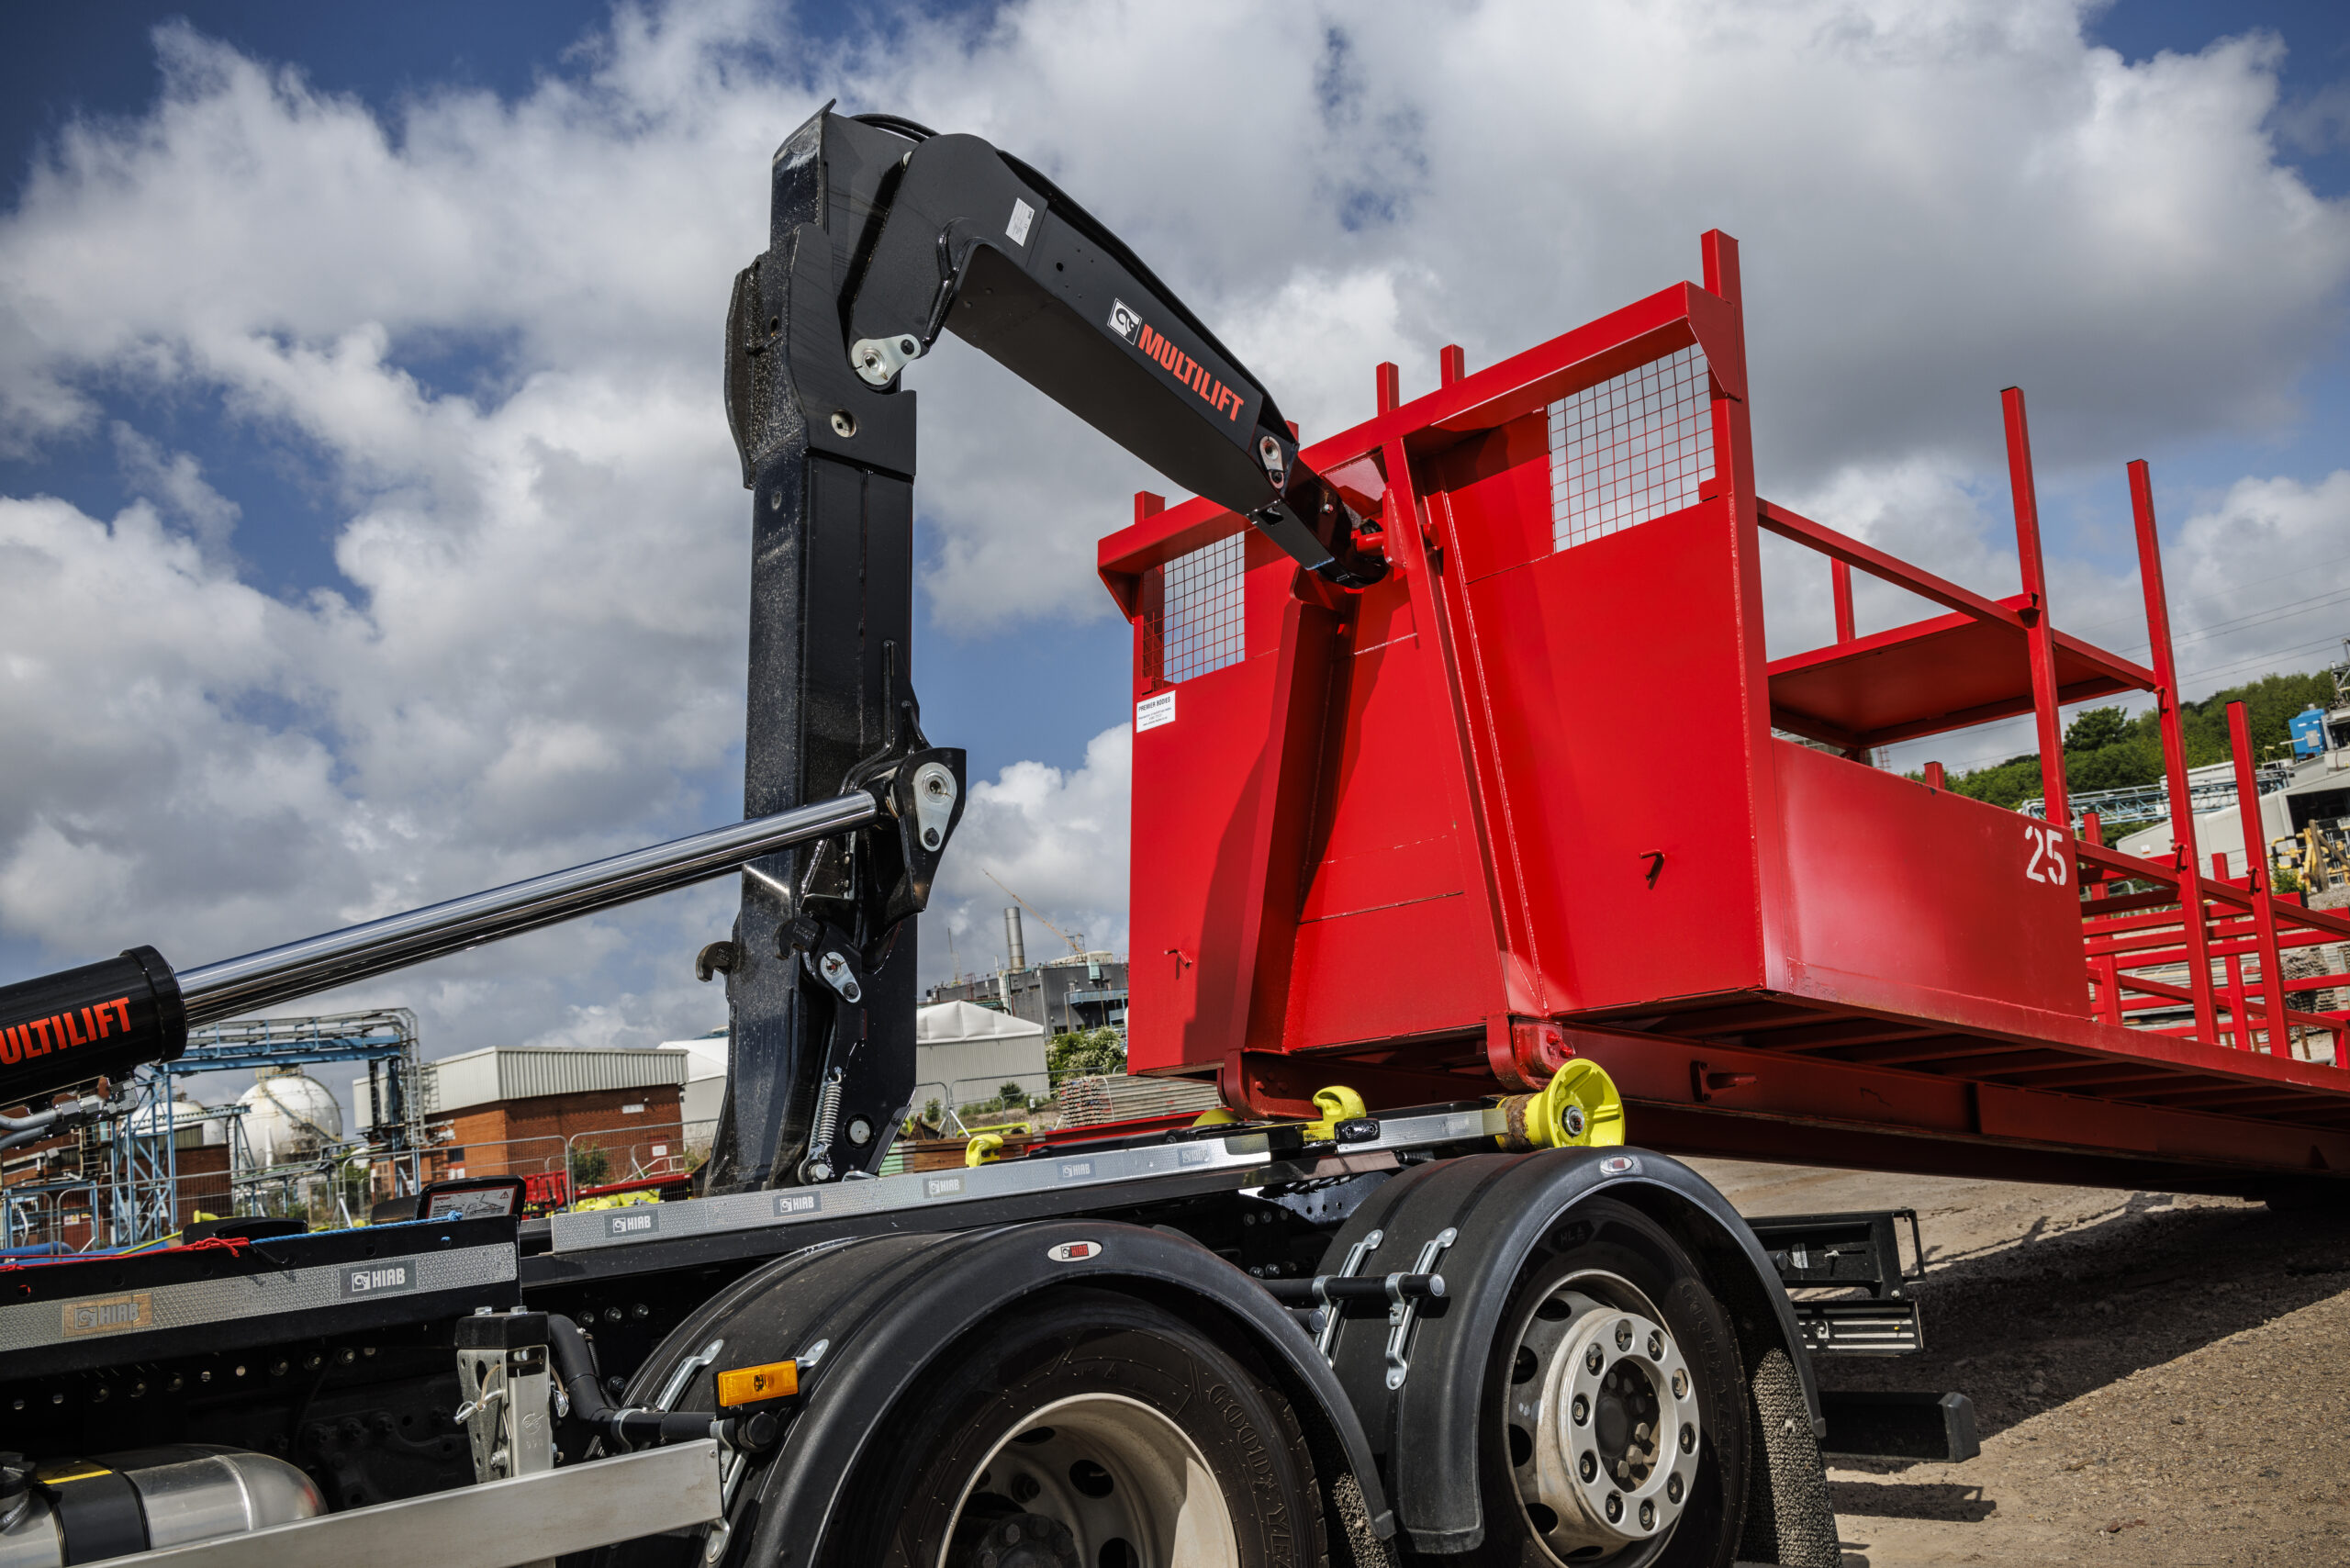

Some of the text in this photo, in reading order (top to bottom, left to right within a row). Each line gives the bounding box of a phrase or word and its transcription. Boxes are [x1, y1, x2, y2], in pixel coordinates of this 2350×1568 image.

[1138, 323, 1245, 422] MULTILIFT
[2025, 825, 2066, 886] 25
[0, 996, 131, 1065] ULTILIFT
[1072, 1163, 1091, 1175] HIAB
[940, 1179, 959, 1192] HIAB
[792, 1195, 814, 1210] HIAB
[626, 1215, 652, 1231] HIAB
[1070, 1244, 1089, 1257] HIAB
[372, 1267, 406, 1288] HIAB
[99, 1303, 140, 1325] HIAB
